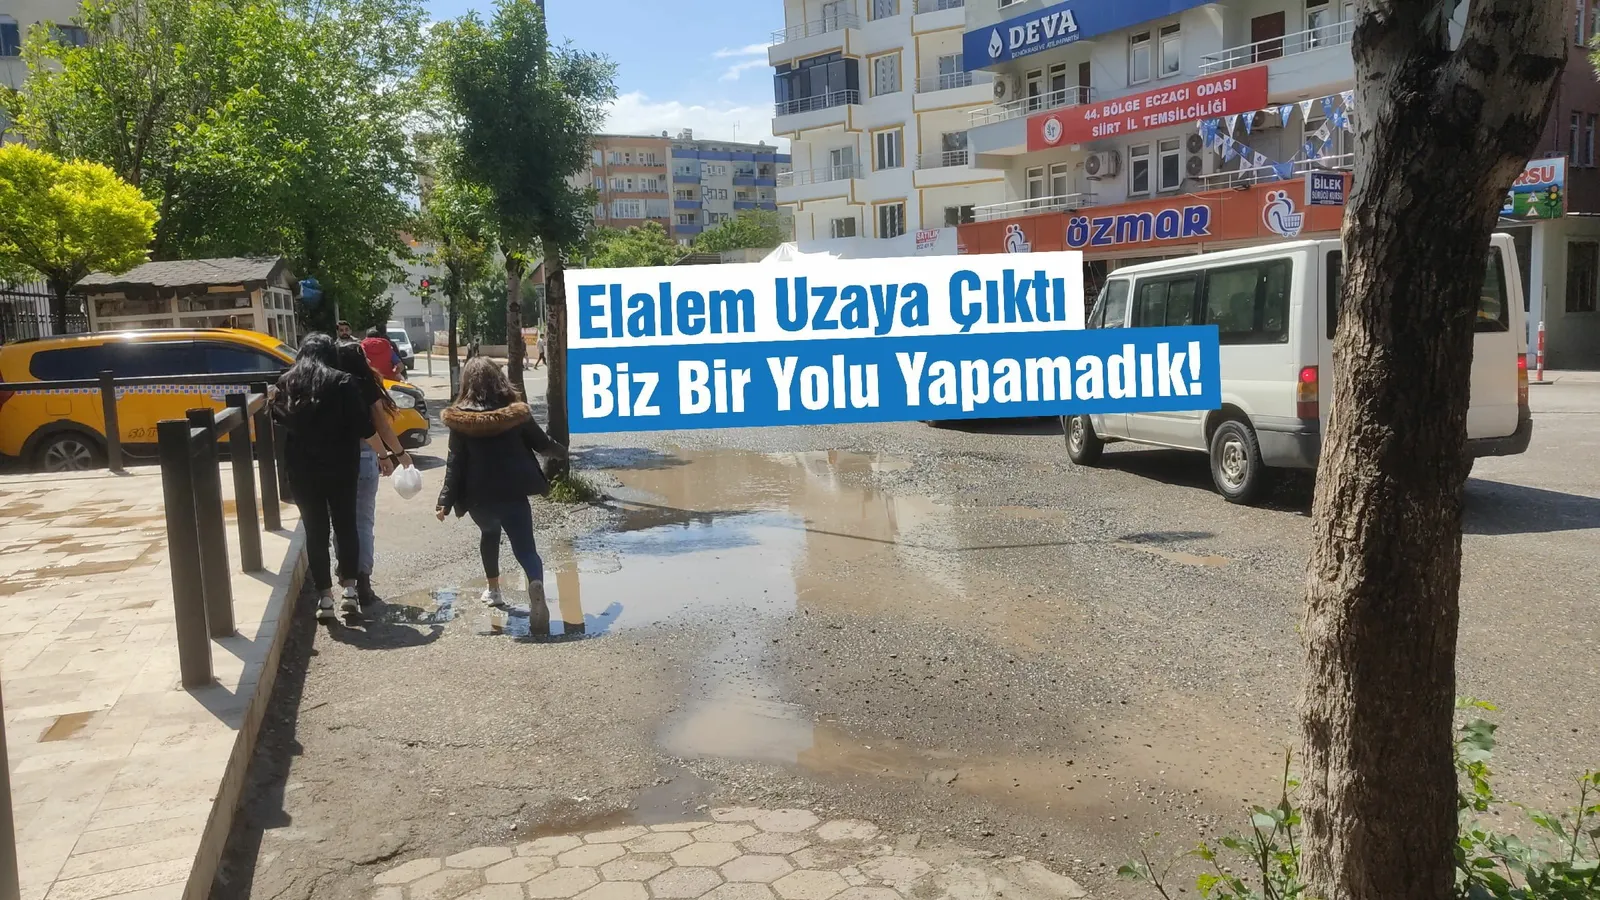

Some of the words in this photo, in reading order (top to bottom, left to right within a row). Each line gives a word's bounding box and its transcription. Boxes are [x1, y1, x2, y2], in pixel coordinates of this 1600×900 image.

[1009, 9, 1077, 49] DEVA
[1084, 109, 1100, 121] 44.
[1103, 99, 1140, 118] BÖLGE
[1145, 91, 1190, 108] ECZACI
[1197, 78, 1237, 97] ODASI
[1092, 121, 1120, 138] SİİRT
[1127, 117, 1138, 131] İL
[1143, 98, 1227, 128] TEMSİLCİLİĞİ
[1314, 176, 1342, 190] BİLEK
[1513, 164, 1556, 187] RSU
